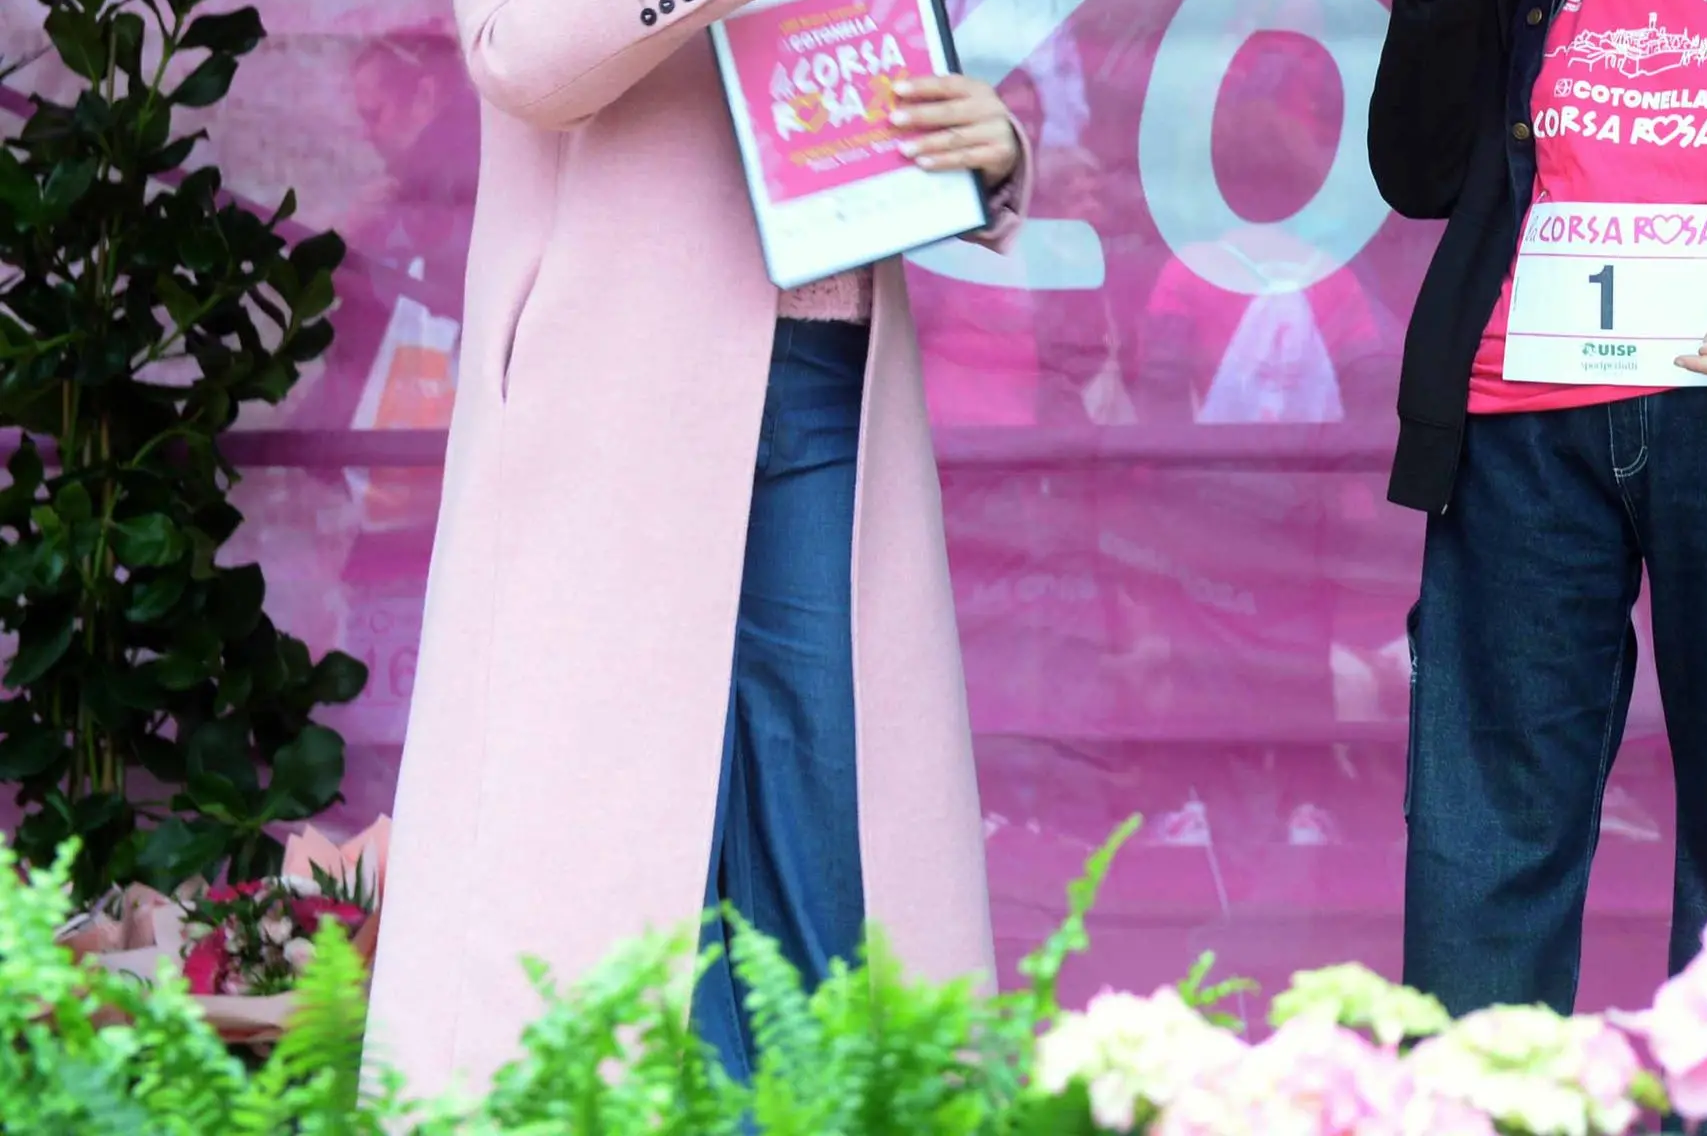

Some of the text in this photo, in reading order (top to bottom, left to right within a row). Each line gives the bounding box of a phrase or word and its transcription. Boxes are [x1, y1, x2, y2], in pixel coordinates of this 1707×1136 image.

[1533, 105, 1621, 144] CORSA
[1539, 214, 1623, 246] CORSA
[1588, 264, 1614, 330] 1
[1598, 343, 1637, 357] UISP
